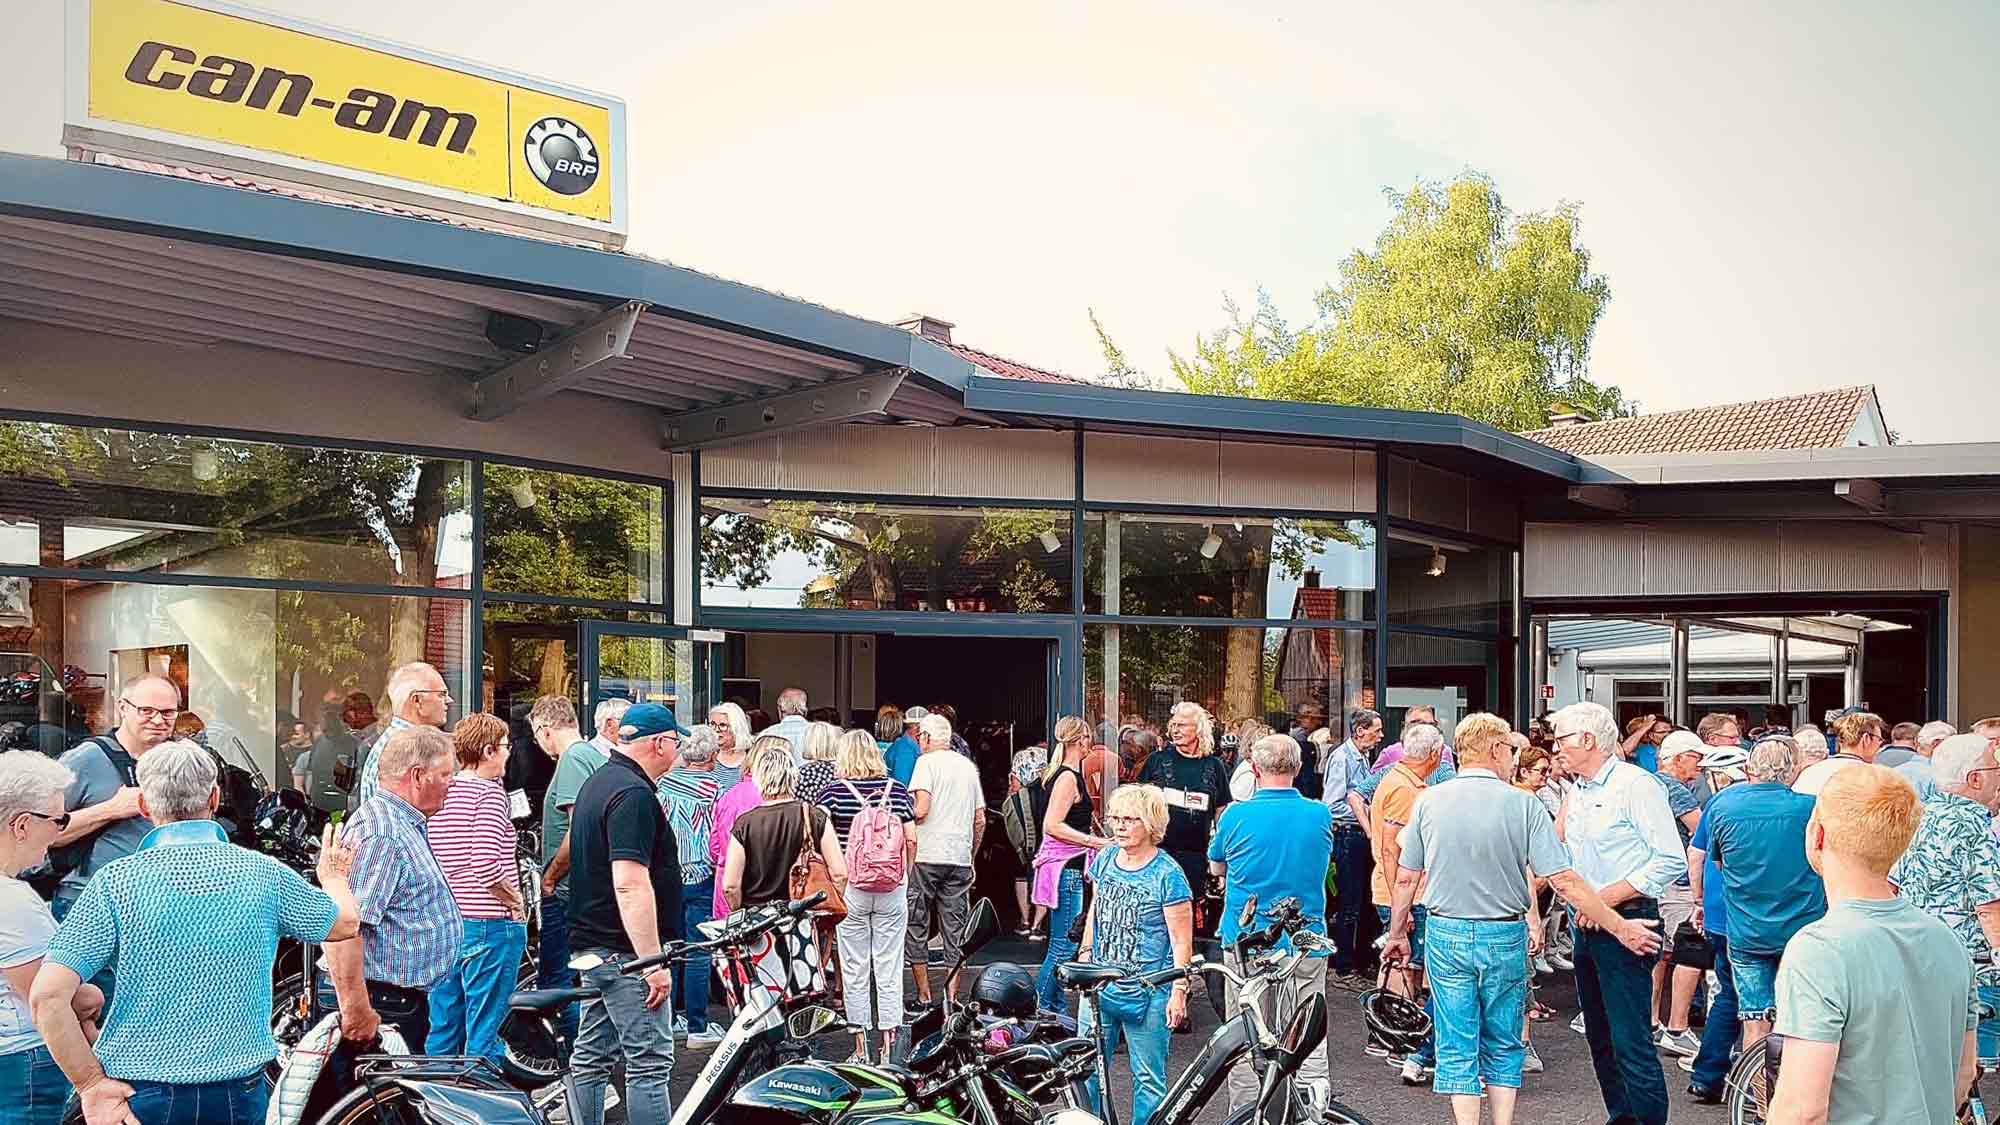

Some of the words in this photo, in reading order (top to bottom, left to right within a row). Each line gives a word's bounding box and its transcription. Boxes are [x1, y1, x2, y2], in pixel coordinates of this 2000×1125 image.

[125, 40, 478, 155] can-am
[554, 158, 597, 177] BRP
[706, 1041, 738, 1084] PEGASUS
[768, 1079, 822, 1096] Kawasaki
